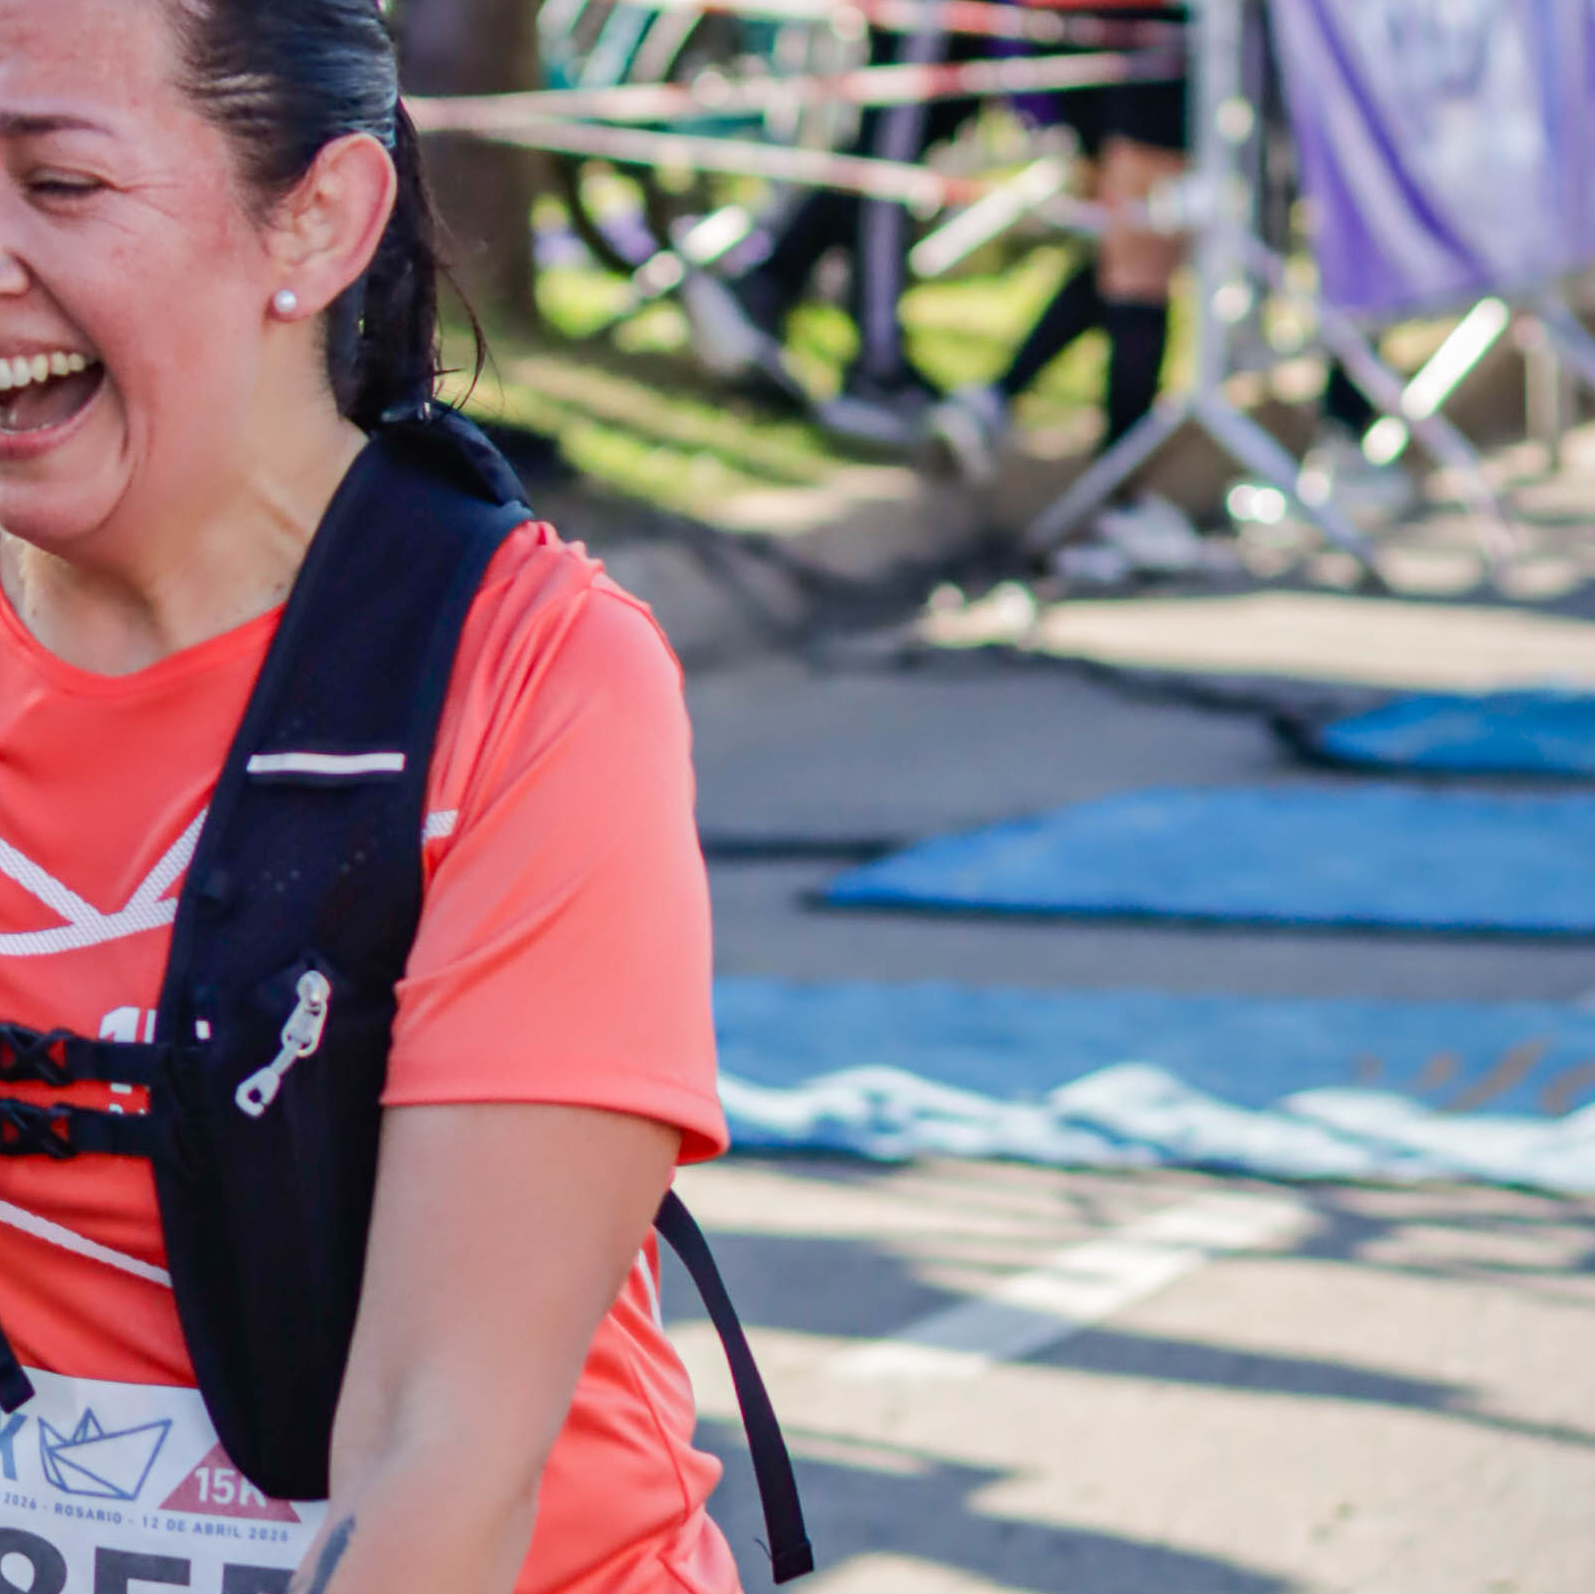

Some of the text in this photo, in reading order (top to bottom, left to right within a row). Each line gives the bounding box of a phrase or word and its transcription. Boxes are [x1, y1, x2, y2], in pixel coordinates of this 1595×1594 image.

[4, 1491, 37, 1511] 2026
[55, 1502, 122, 1525] ROSARIO
[142, 1515, 159, 1530] 12
[166, 1518, 184, 1532] DE
[192, 1520, 242, 1539] ABRIL
[249, 1527, 289, 1542] 2026
